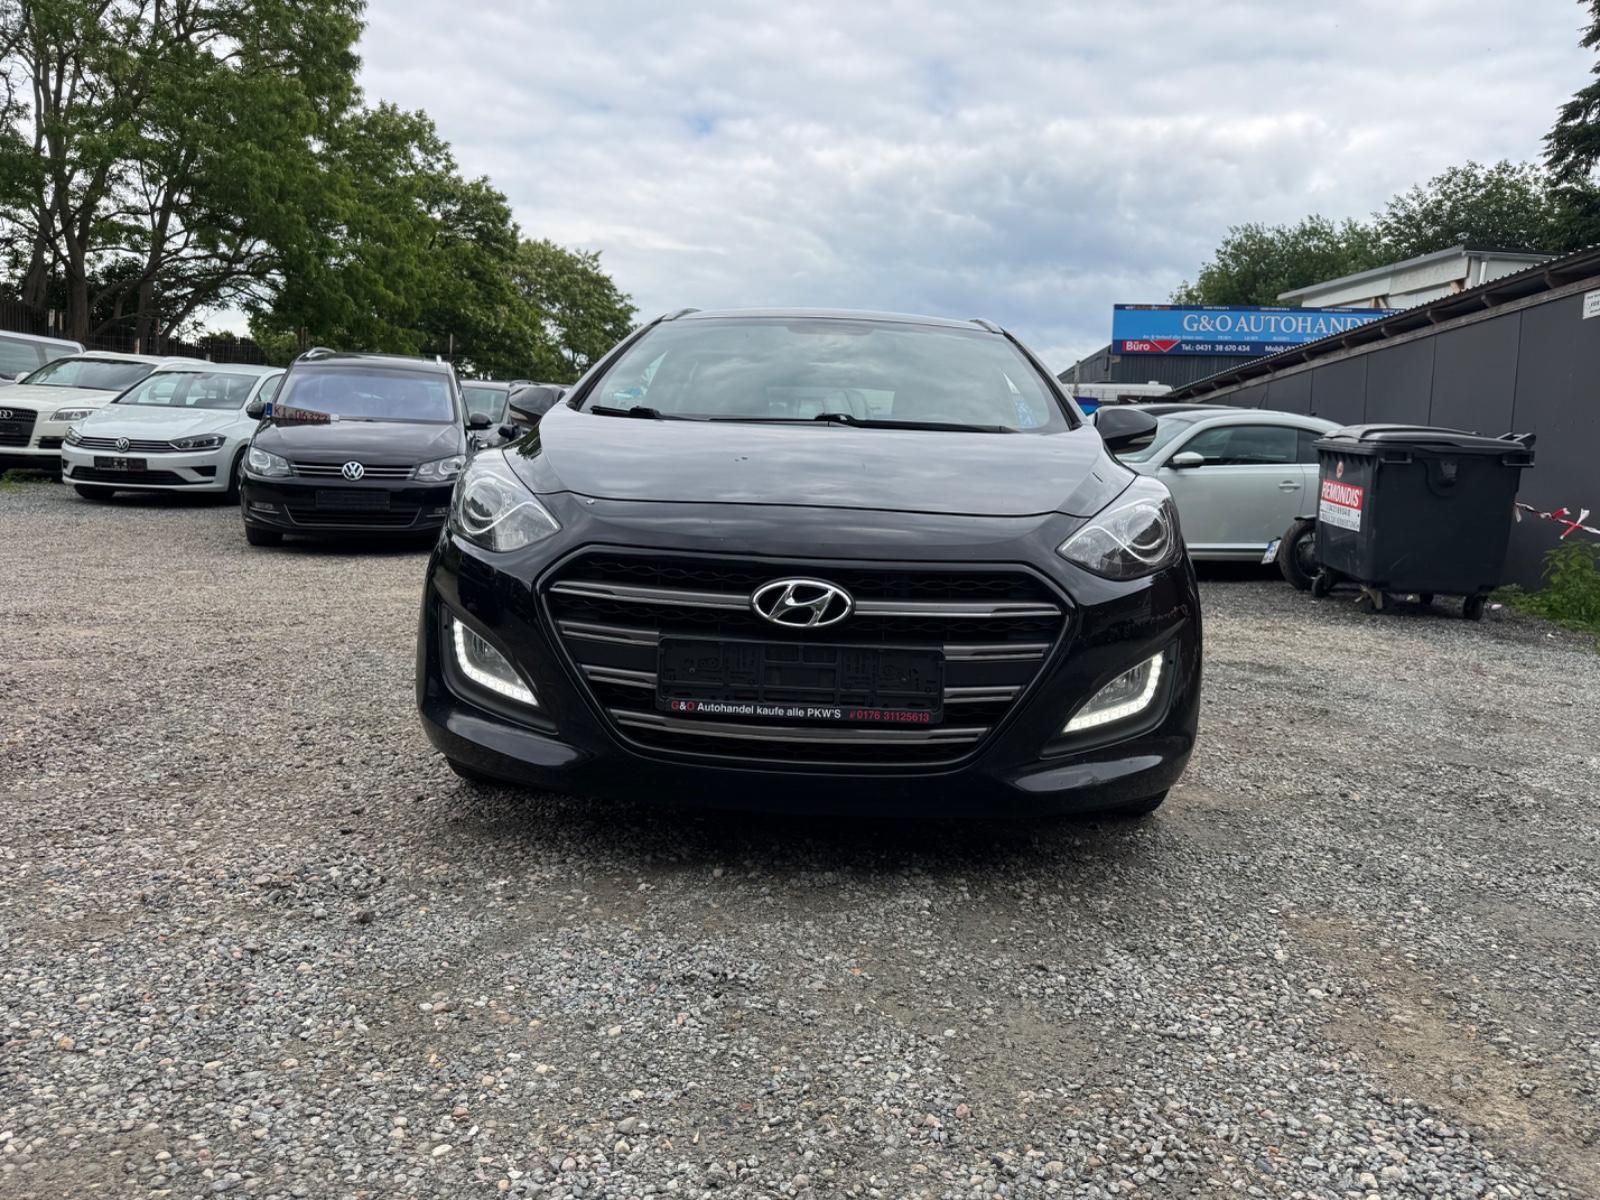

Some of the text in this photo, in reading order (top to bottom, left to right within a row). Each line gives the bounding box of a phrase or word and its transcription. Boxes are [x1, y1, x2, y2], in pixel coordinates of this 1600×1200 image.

[1183, 314, 1232, 332] G&O
[1125, 341, 1150, 351] Büro
[1195, 344, 1212, 352] 0431
[671, 700, 695, 711] G&O
[697, 702, 754, 715] Autohandel
[756, 705, 785, 717] kaufe
[786, 707, 805, 717] alle
[807, 707, 841, 719] PKW'S
